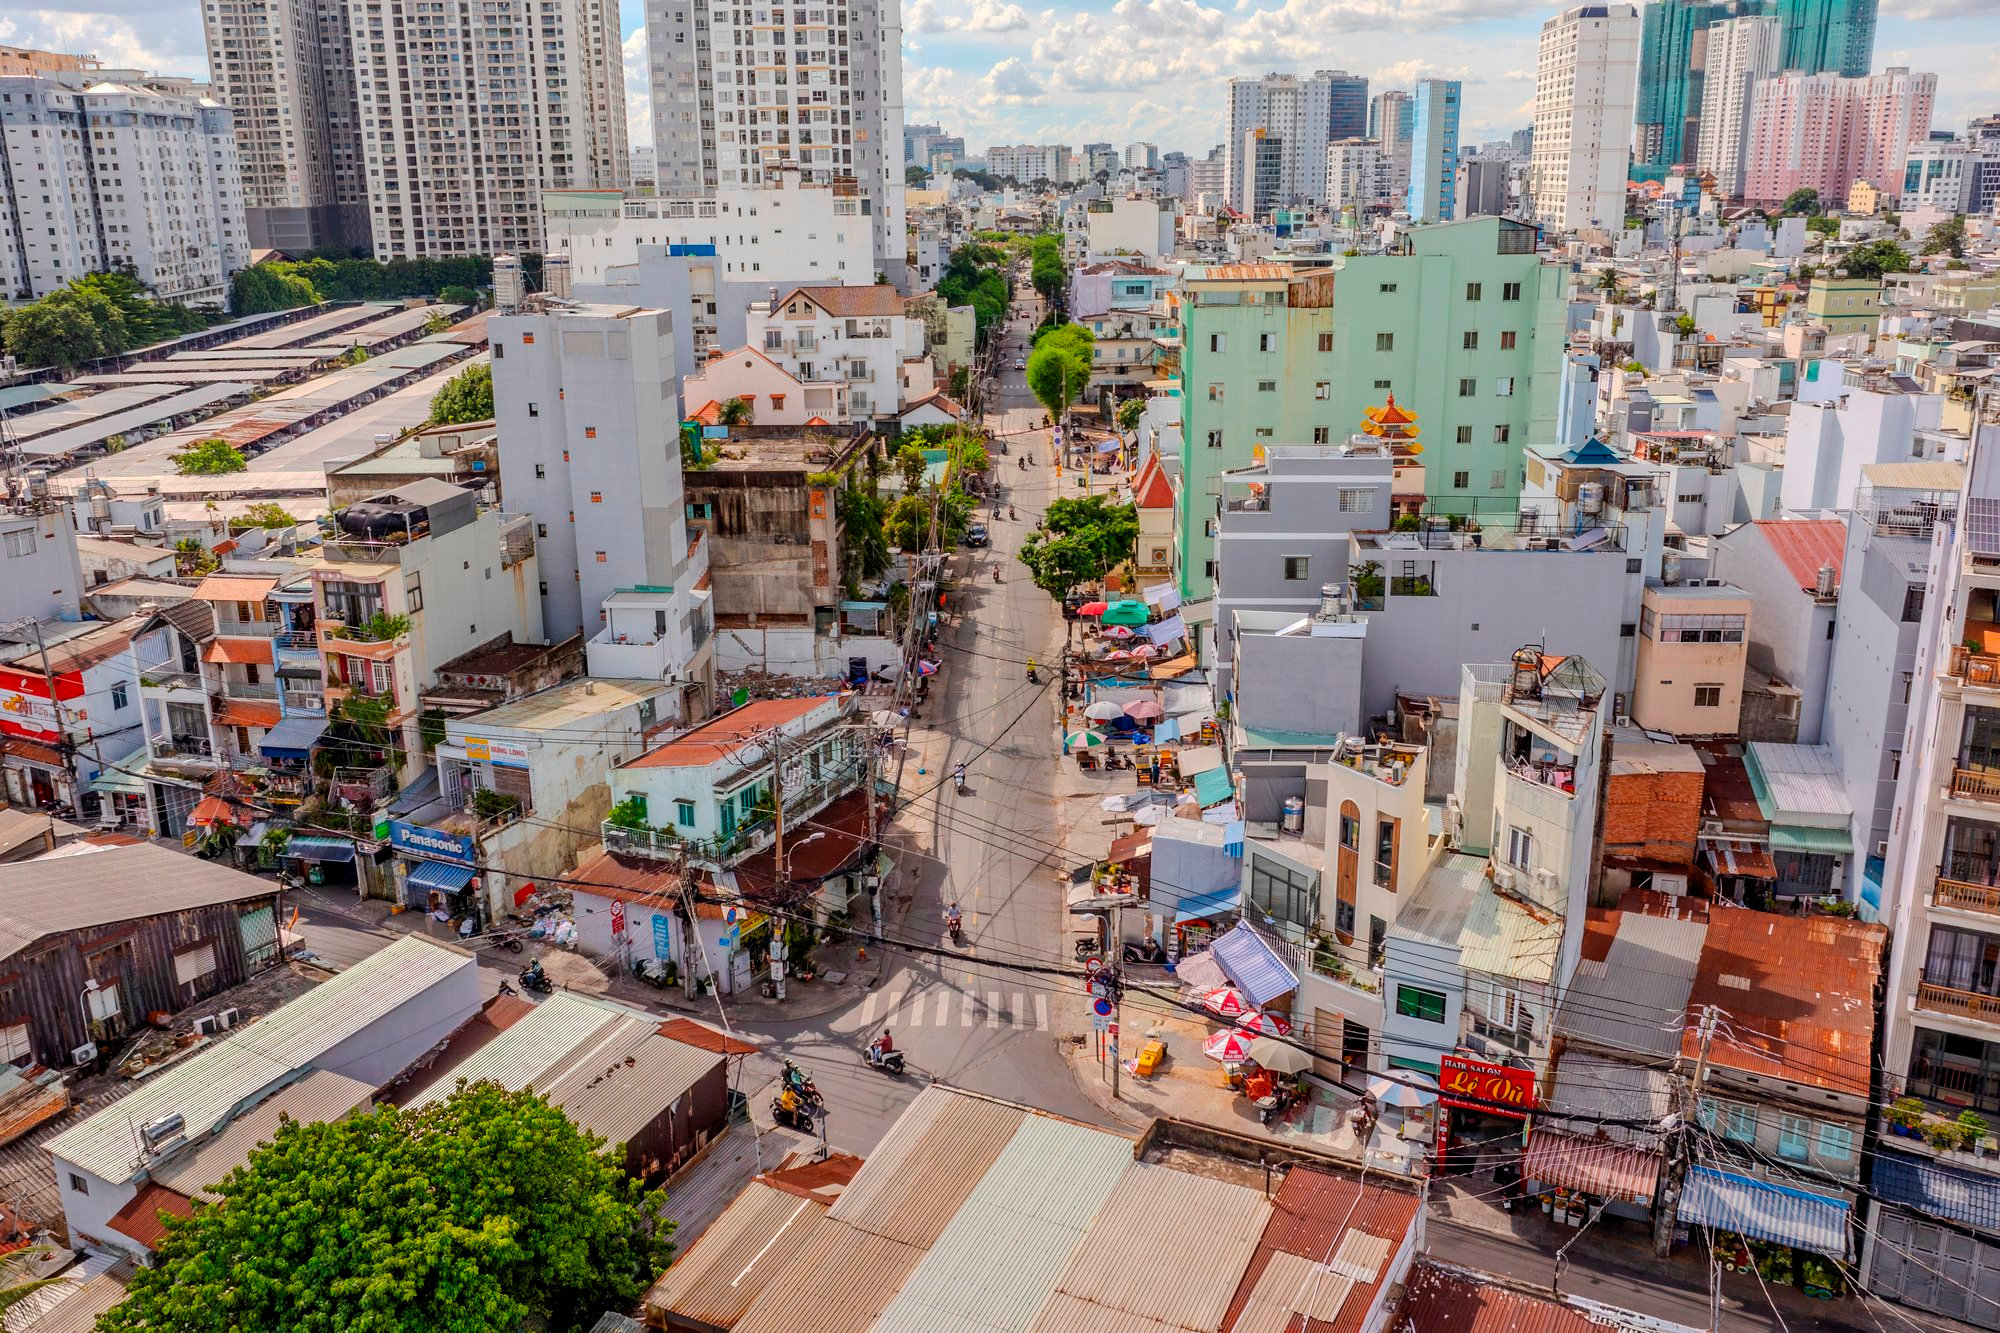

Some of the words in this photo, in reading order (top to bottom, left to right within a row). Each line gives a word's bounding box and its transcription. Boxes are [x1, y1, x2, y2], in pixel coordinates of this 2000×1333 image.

[401, 828, 463, 854] Panasonic
[1444, 1059, 1467, 1071] HAIR
[1470, 1064, 1502, 1076] SALON
[1447, 1071, 1479, 1095] Lê
